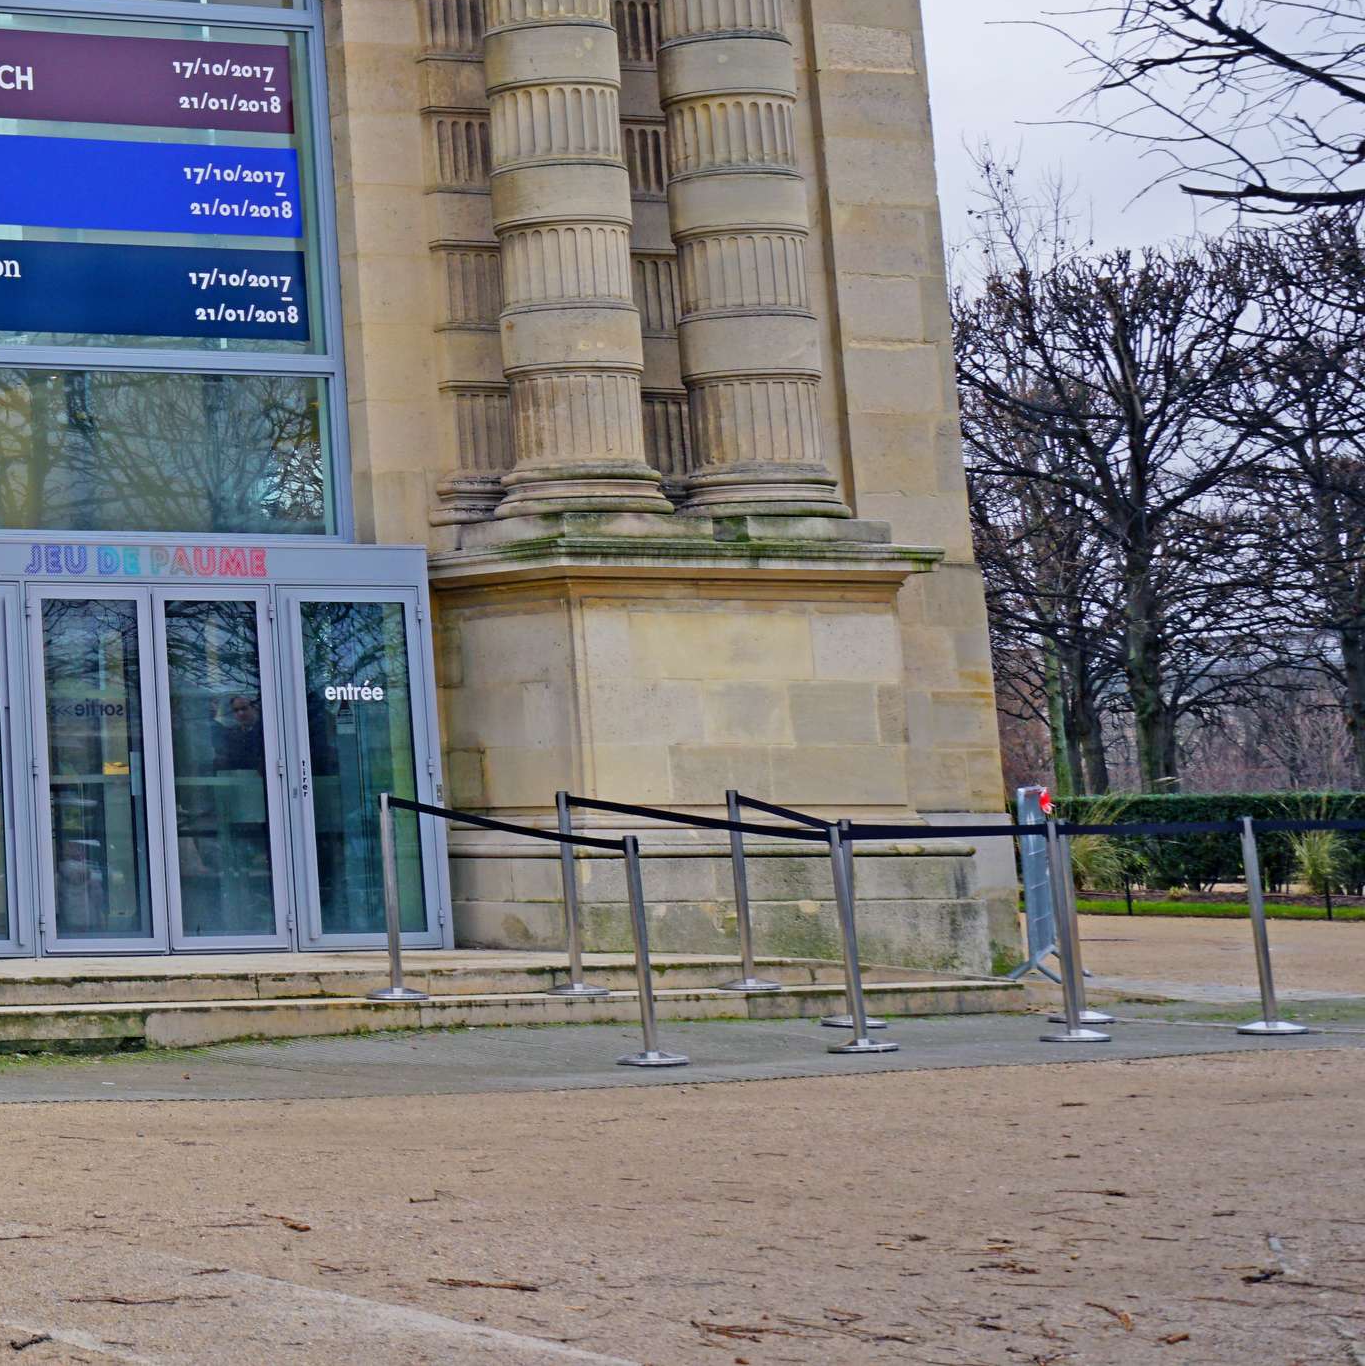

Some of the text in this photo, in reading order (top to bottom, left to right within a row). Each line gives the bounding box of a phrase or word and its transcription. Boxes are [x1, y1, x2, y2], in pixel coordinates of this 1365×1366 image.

[172, 57, 275, 83] 17/10/2017
[178, 92, 282, 114] 21/01/2018
[183, 163, 286, 188] 17/10/2017
[190, 198, 293, 219] 21/01/2018
[188, 268, 292, 293] 17/10/2017
[195, 303, 299, 324] 21/01/2018
[24, 543, 269, 578] JEU DE PAUME
[324, 679, 384, 701] entrée
